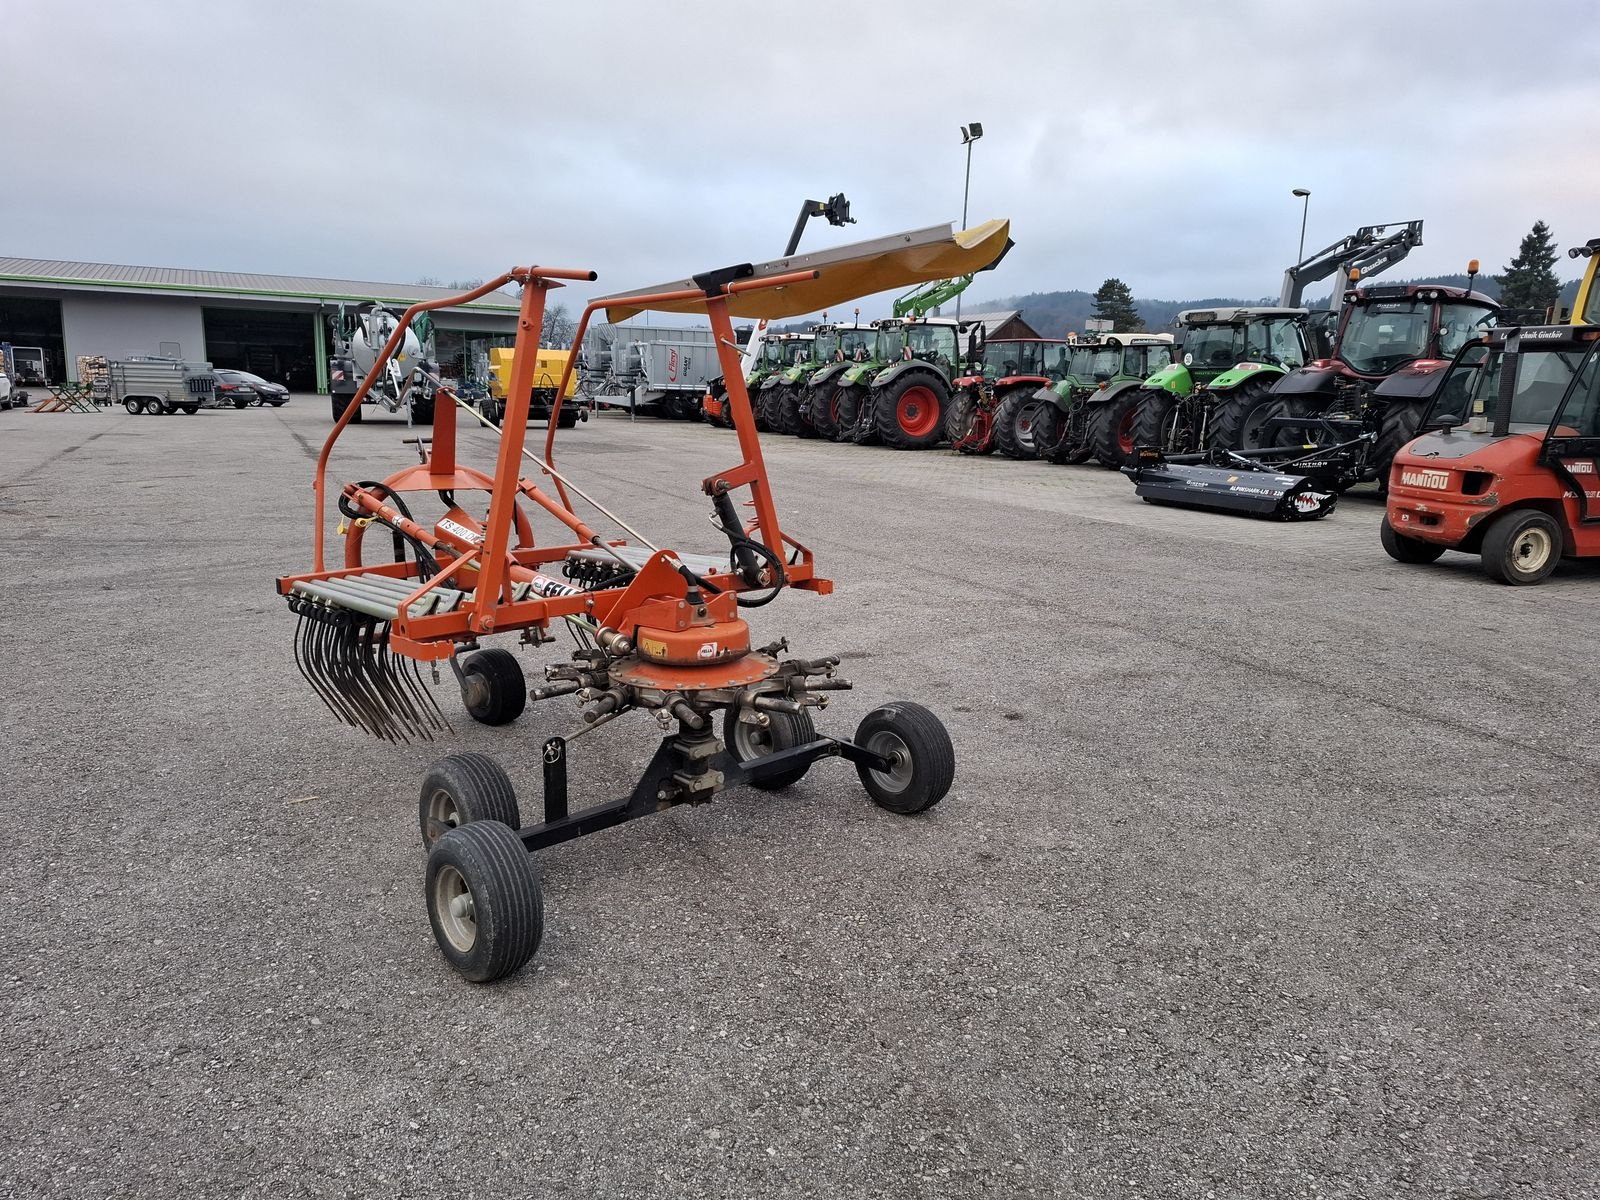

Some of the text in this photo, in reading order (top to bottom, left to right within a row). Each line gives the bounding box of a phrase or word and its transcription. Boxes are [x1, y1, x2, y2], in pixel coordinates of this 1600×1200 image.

[1564, 461, 1592, 473] ANITOU
[1401, 469, 1449, 490] MANITOU
[441, 520, 455, 530] TS
[452, 526, 468, 537] 400
